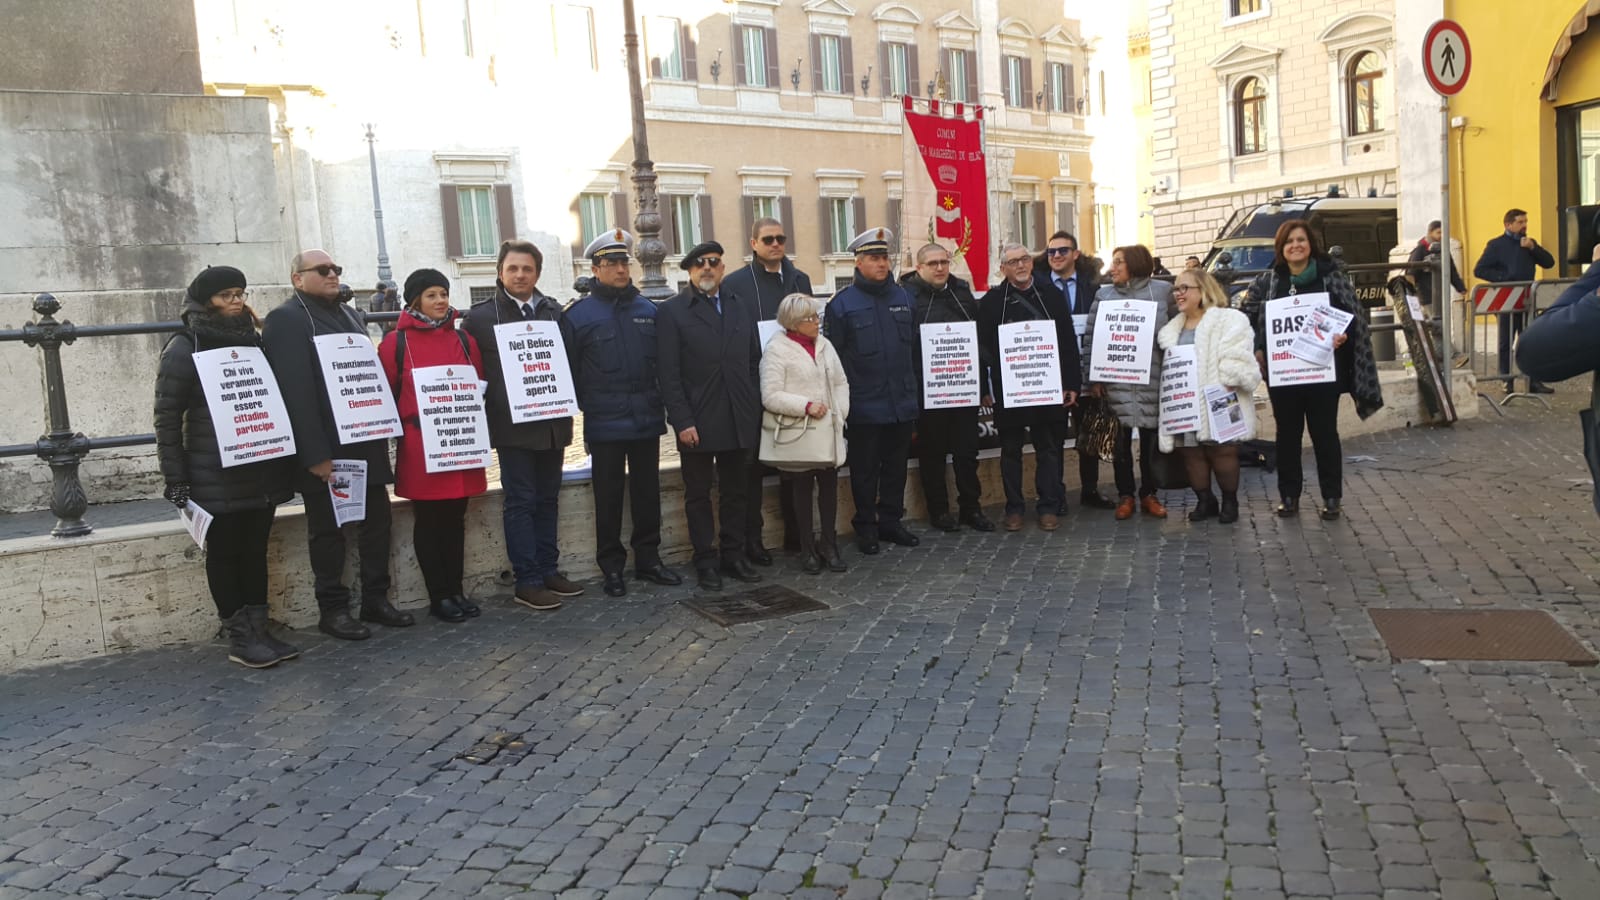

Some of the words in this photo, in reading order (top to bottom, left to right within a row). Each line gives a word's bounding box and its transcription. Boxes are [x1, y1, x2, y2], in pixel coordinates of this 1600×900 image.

[1356, 288, 1386, 300] RABIN
[1121, 314, 1145, 322] Belice
[1272, 315, 1307, 334] BAS
[1112, 333, 1134, 342] ferita
[1276, 338, 1294, 347] ere
[509, 341, 525, 351] Nel
[527, 338, 554, 349] Belice
[1005, 345, 1034, 354] quartiere
[518, 350, 532, 361] c'è
[535, 351, 551, 360] una
[1108, 354, 1135, 362] aperta
[223, 367, 236, 377] Chi
[239, 367, 254, 375] vive
[524, 362, 550, 372] ferita
[346, 373, 378, 382] singhiozzo
[523, 373, 555, 384] ancora
[220, 377, 263, 390] veramente
[421, 384, 449, 393] Quando
[341, 388, 354, 396] che
[526, 384, 557, 397] aperta
[221, 392, 236, 401] non
[234, 401, 262, 411] essere
[348, 398, 382, 408] Elemosine
[423, 406, 452, 415] qualche
[455, 404, 481, 413] secondo
[234, 411, 269, 423] cittadino
[236, 422, 274, 436] partecipe
[450, 438, 475, 446] silenzio
